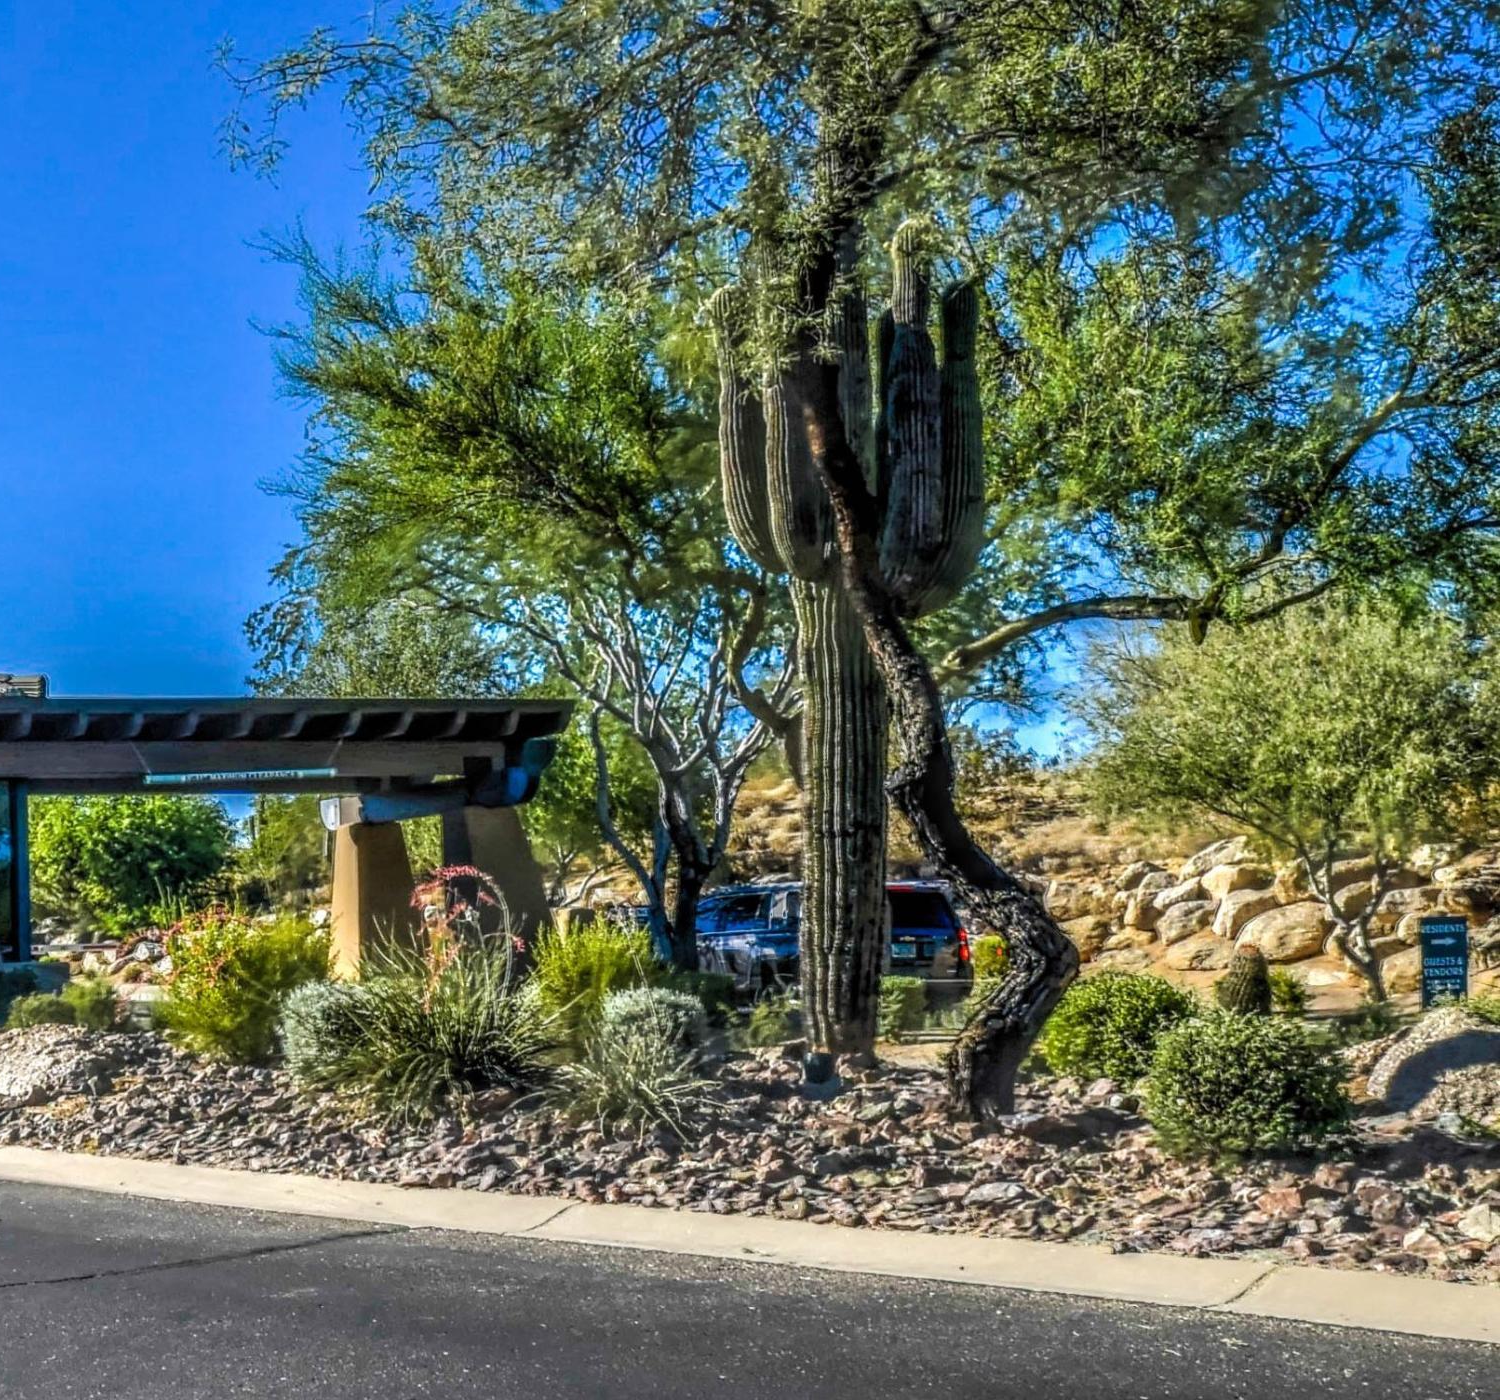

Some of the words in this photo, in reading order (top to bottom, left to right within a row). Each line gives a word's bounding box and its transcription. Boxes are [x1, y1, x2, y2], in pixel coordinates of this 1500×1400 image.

[1421, 924, 1465, 933] RESIDENTS
[1423, 957, 1455, 966] GUESTS
[1423, 967, 1463, 977] VENDORS
